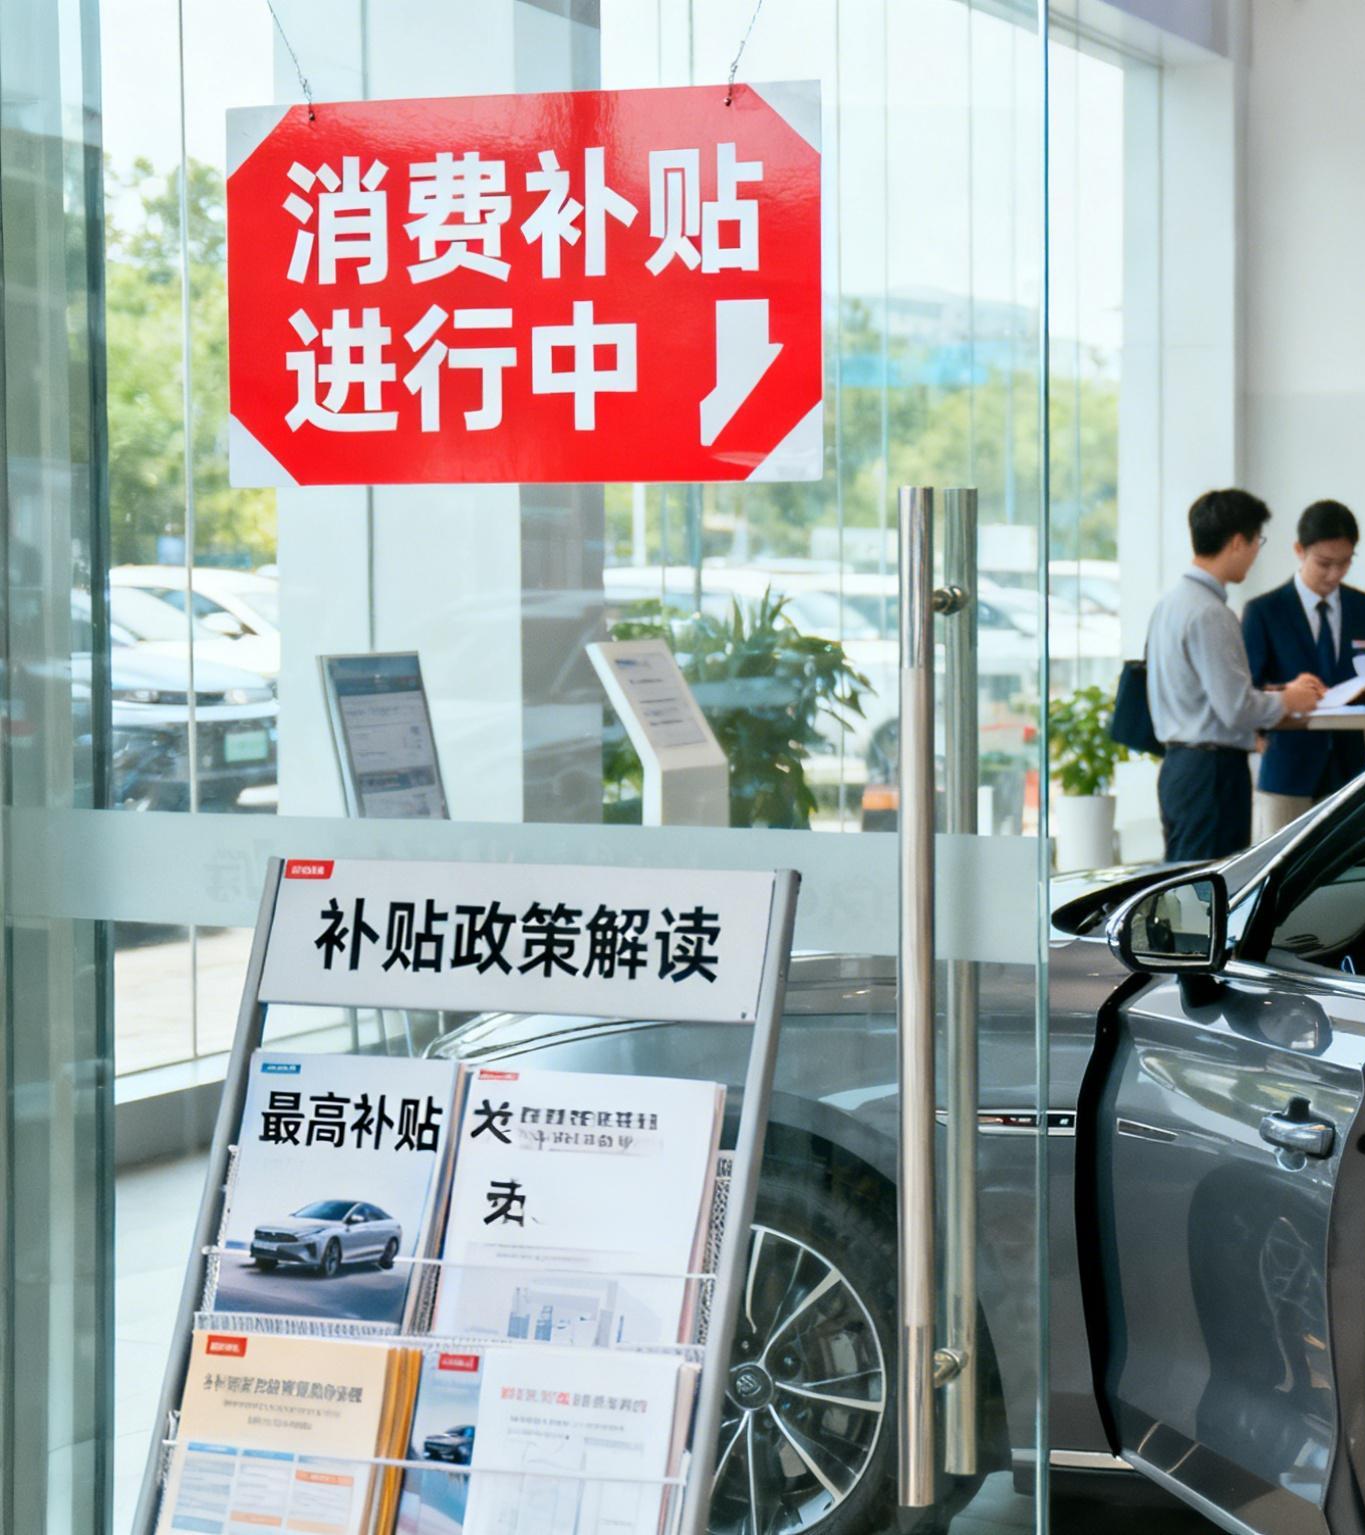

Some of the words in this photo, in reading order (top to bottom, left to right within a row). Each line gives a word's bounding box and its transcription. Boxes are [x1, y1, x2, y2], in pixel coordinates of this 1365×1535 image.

[282, 141, 765, 285] 消费补贴
[284, 300, 638, 433] 进行中
[314, 897, 722, 984] 补贴政策解读
[258, 1089, 444, 1153] 最高补贴
